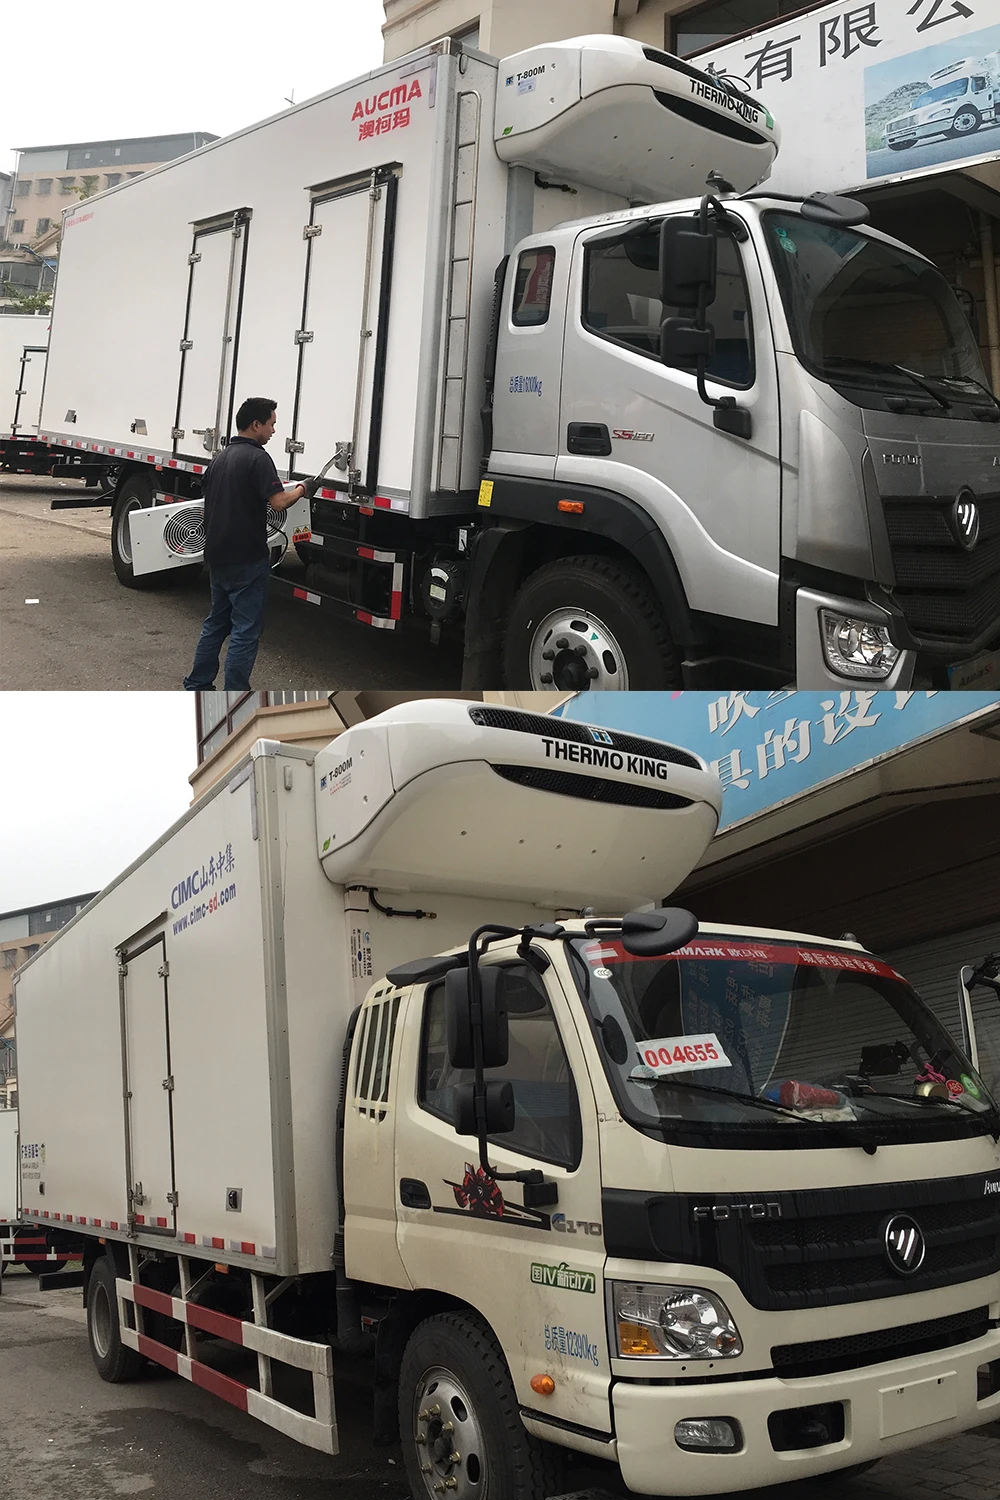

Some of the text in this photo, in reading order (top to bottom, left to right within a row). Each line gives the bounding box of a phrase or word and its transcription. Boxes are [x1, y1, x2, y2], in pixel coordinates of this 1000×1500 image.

[517, 65, 546, 81] T-800M
[351, 79, 422, 121] AUCMA
[690, 79, 759, 123] THERMO KING
[358, 107, 411, 141] 澳柯玛
[329, 757, 353, 782] T-800M
[541, 738, 668, 781] THERMO KING
[172, 883, 237, 936] www.cimc-sd.com
[643, 1043, 719, 1068] 004655
